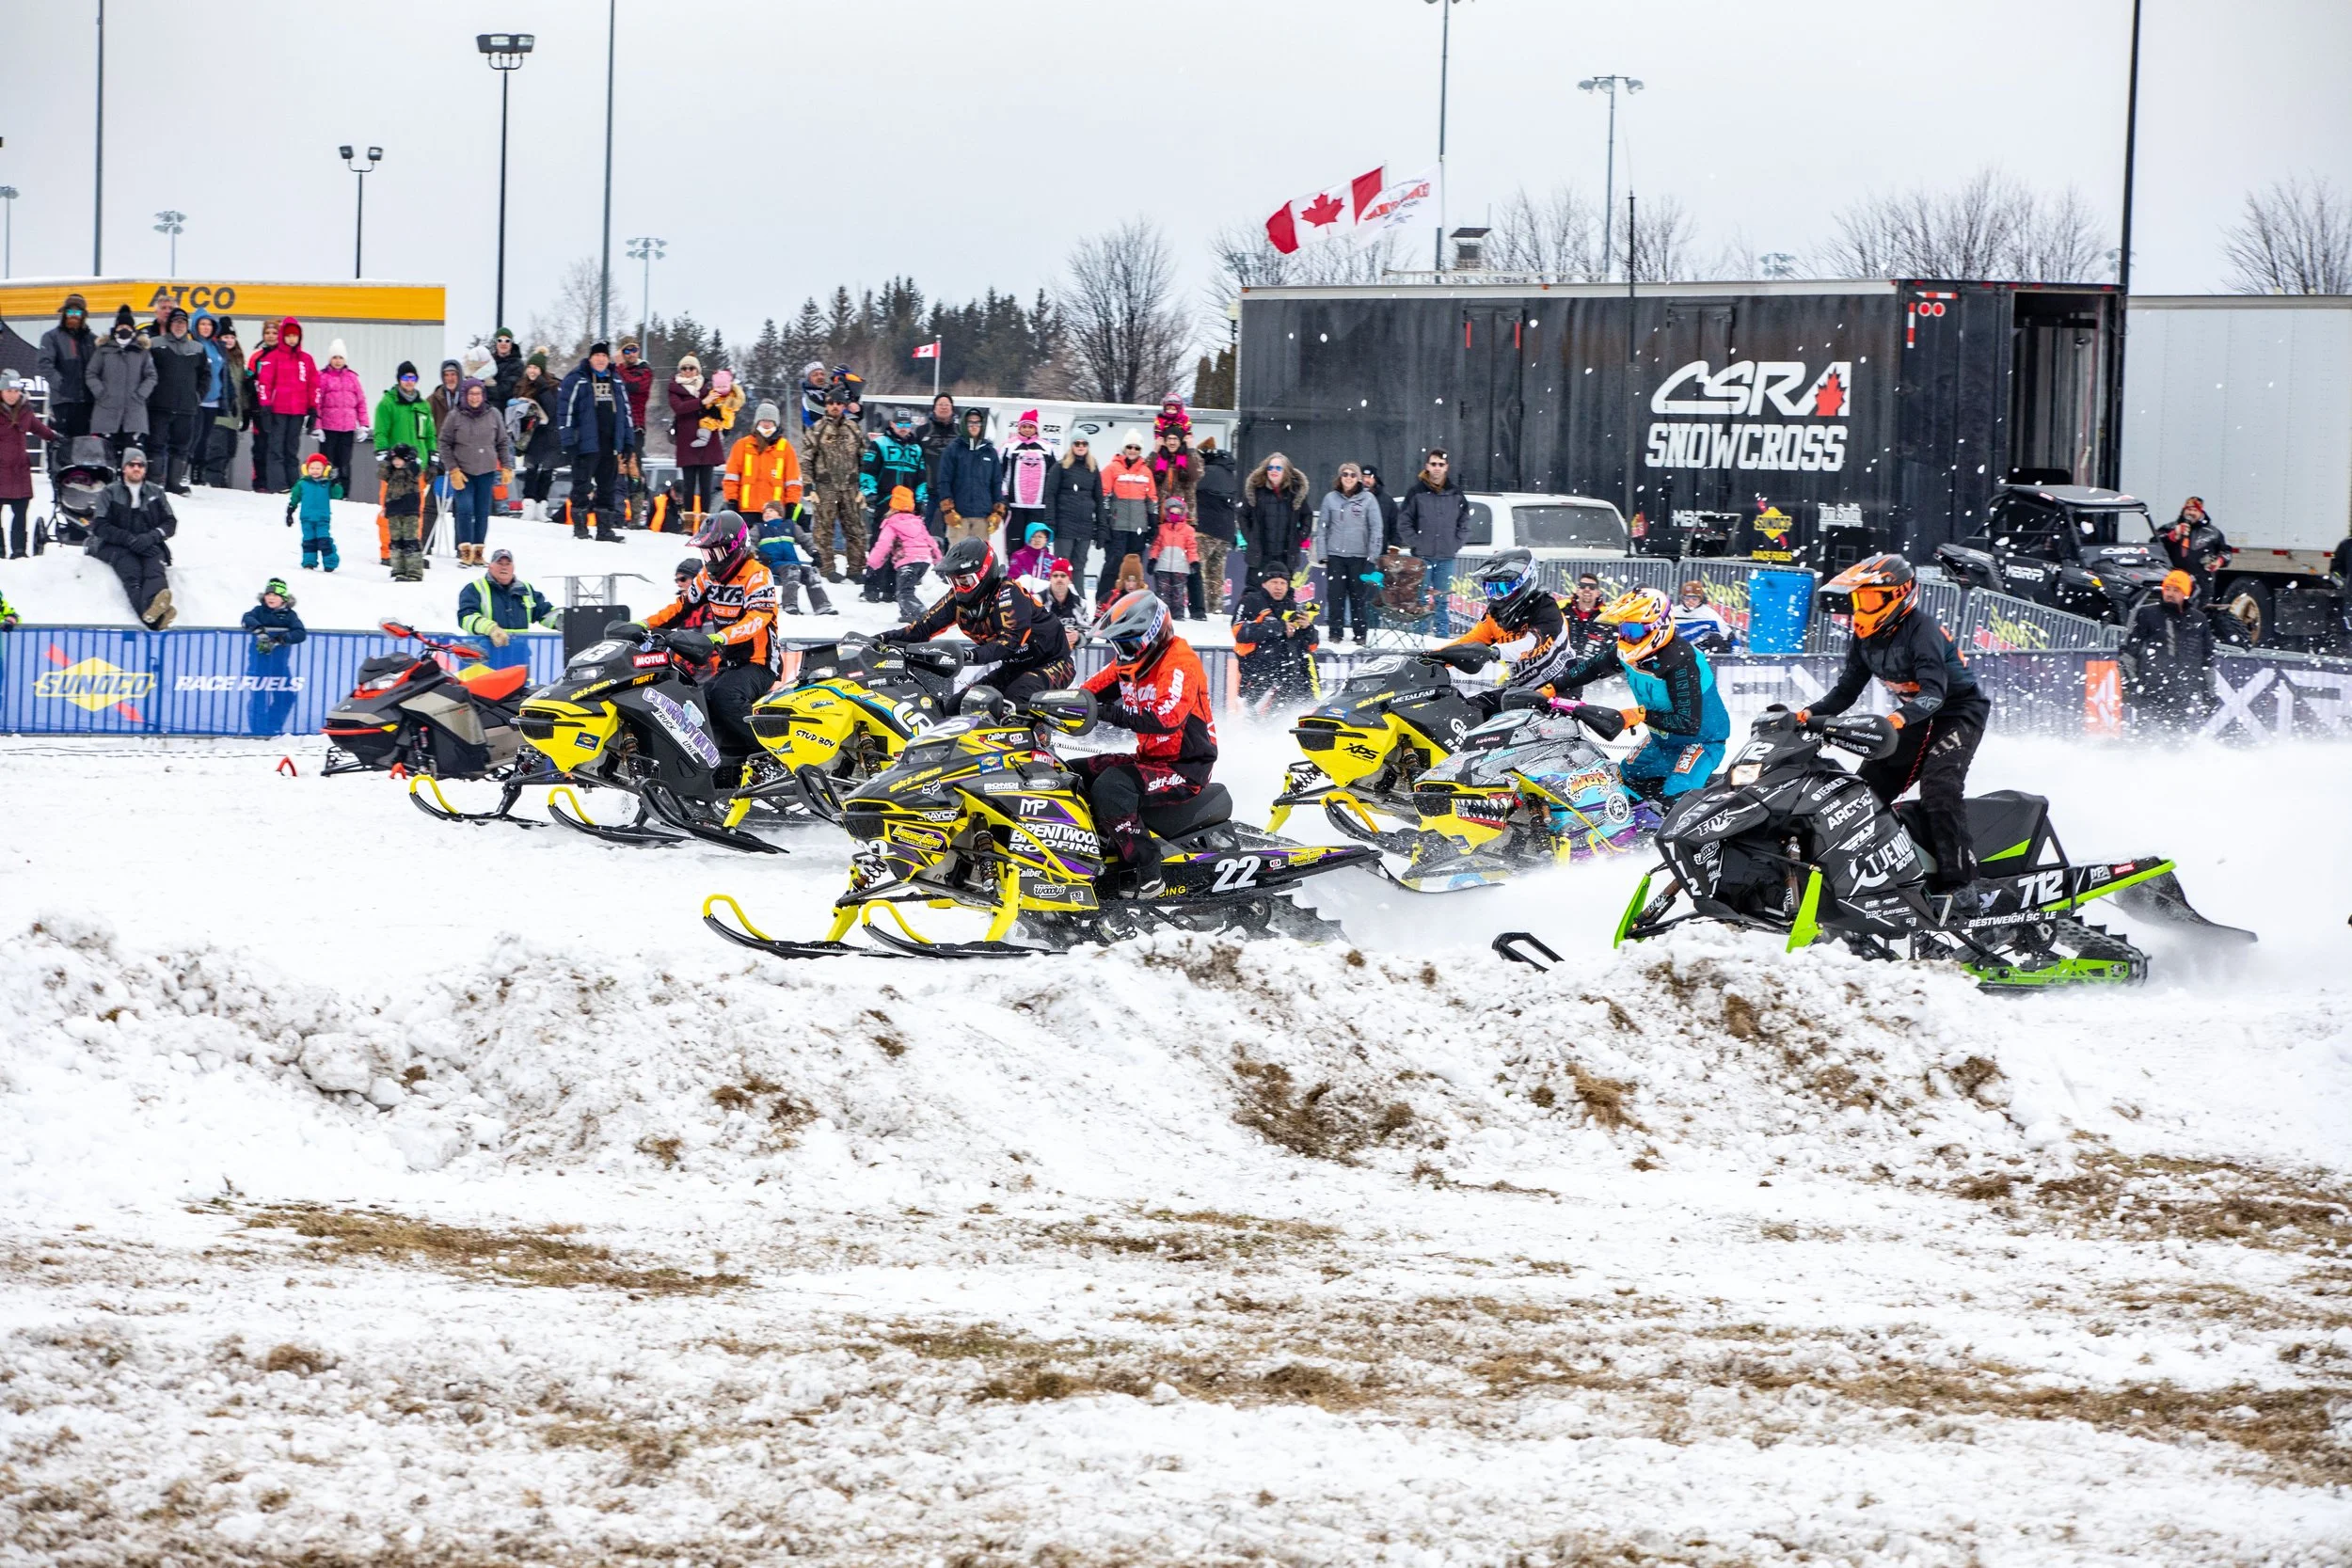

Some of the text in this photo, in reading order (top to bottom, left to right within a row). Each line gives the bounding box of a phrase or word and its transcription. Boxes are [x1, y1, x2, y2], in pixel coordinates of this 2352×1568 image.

[149, 286, 235, 309] ATCO
[1651, 360, 1851, 417] CSRA
[886, 445, 922, 462] FXR
[1645, 422, 1849, 471] SNOWCROSS
[706, 585, 744, 604] FXR
[1892, 581, 1912, 600] FLY
[730, 617, 764, 639] FXR
[635, 655, 666, 666] MOTUL
[41, 673, 305, 696] SUNOCO RACE FUELS
[570, 681, 611, 701] ski-doo
[1356, 690, 1396, 708] ski-doo
[1391, 689, 1436, 705] METALFAB
[656, 710, 677, 732] TRUCK
[795, 730, 835, 749] STUD BOY
[987, 733, 1007, 742] Caliber
[1034, 754, 1055, 767] MOTU
[1343, 743, 1381, 760] XPS
[889, 768, 942, 793] ski-doo
[1820, 800, 1842, 816] TEAM
[1696, 809, 1729, 836] FOX
[1009, 839, 1100, 855] ROOFING
[1211, 855, 1261, 893] 22
[2017, 870, 2063, 909] 712
[1883, 907, 1910, 916] BAYSIDE
[1968, 911, 2057, 928] BESTWEIGH SCLE
